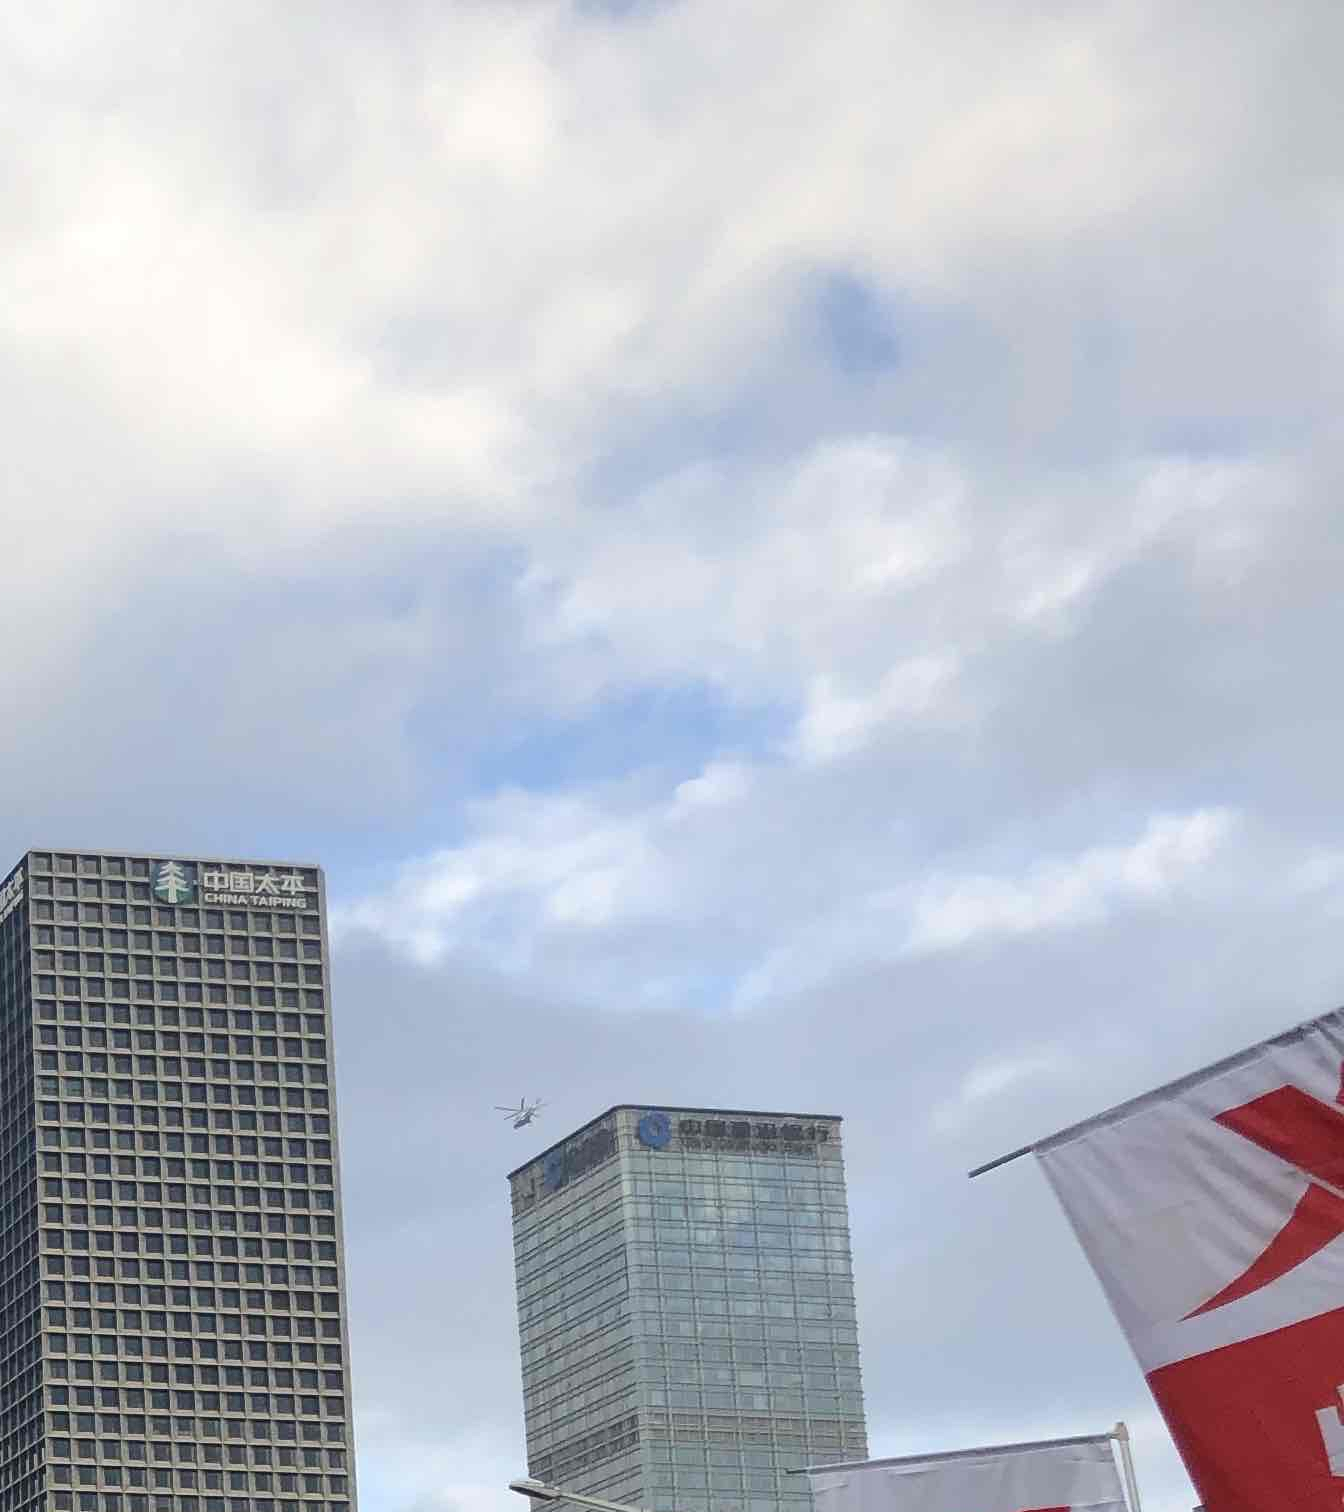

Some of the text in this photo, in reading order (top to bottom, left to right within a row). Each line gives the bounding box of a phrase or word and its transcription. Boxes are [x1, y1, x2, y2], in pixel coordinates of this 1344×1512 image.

[202, 870, 306, 896] 中国太平
[204, 893, 308, 910] CHINA TAIPING
